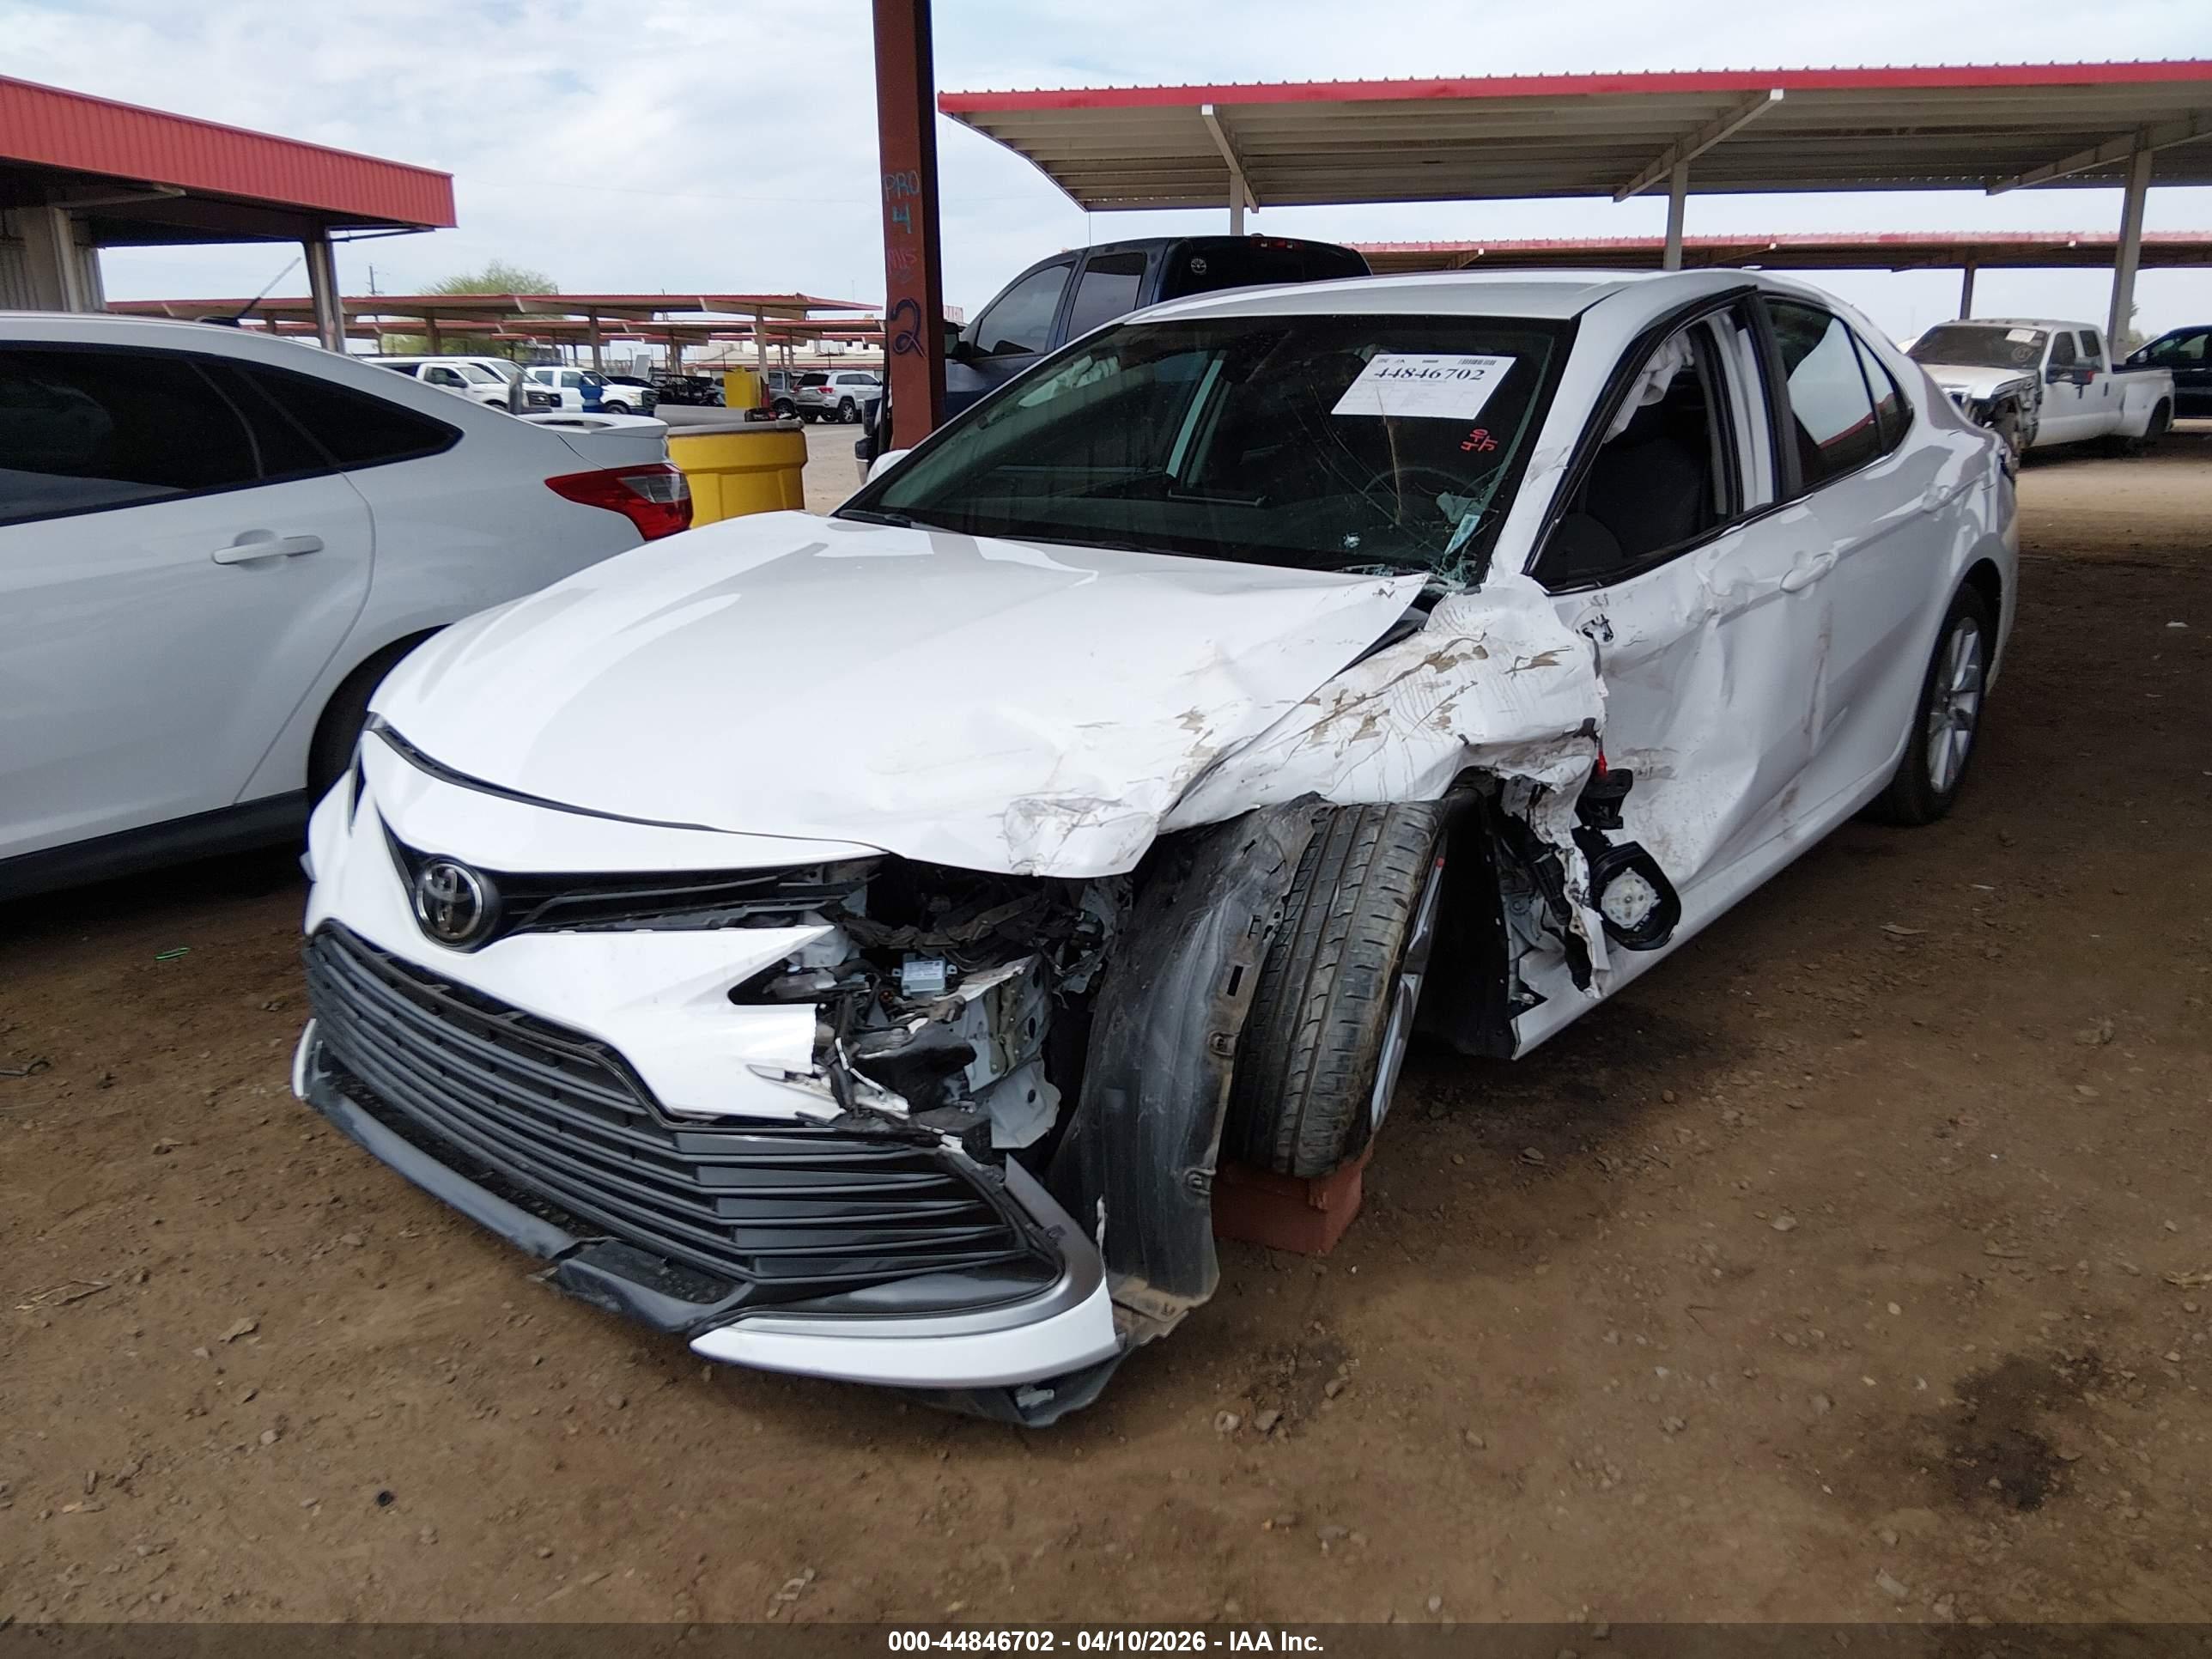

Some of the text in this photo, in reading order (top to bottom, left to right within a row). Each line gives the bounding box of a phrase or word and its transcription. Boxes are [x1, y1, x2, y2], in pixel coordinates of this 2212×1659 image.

[892, 203, 912, 234] 4
[890, 297, 927, 359] 2
[1374, 367, 1486, 380] 44846702
